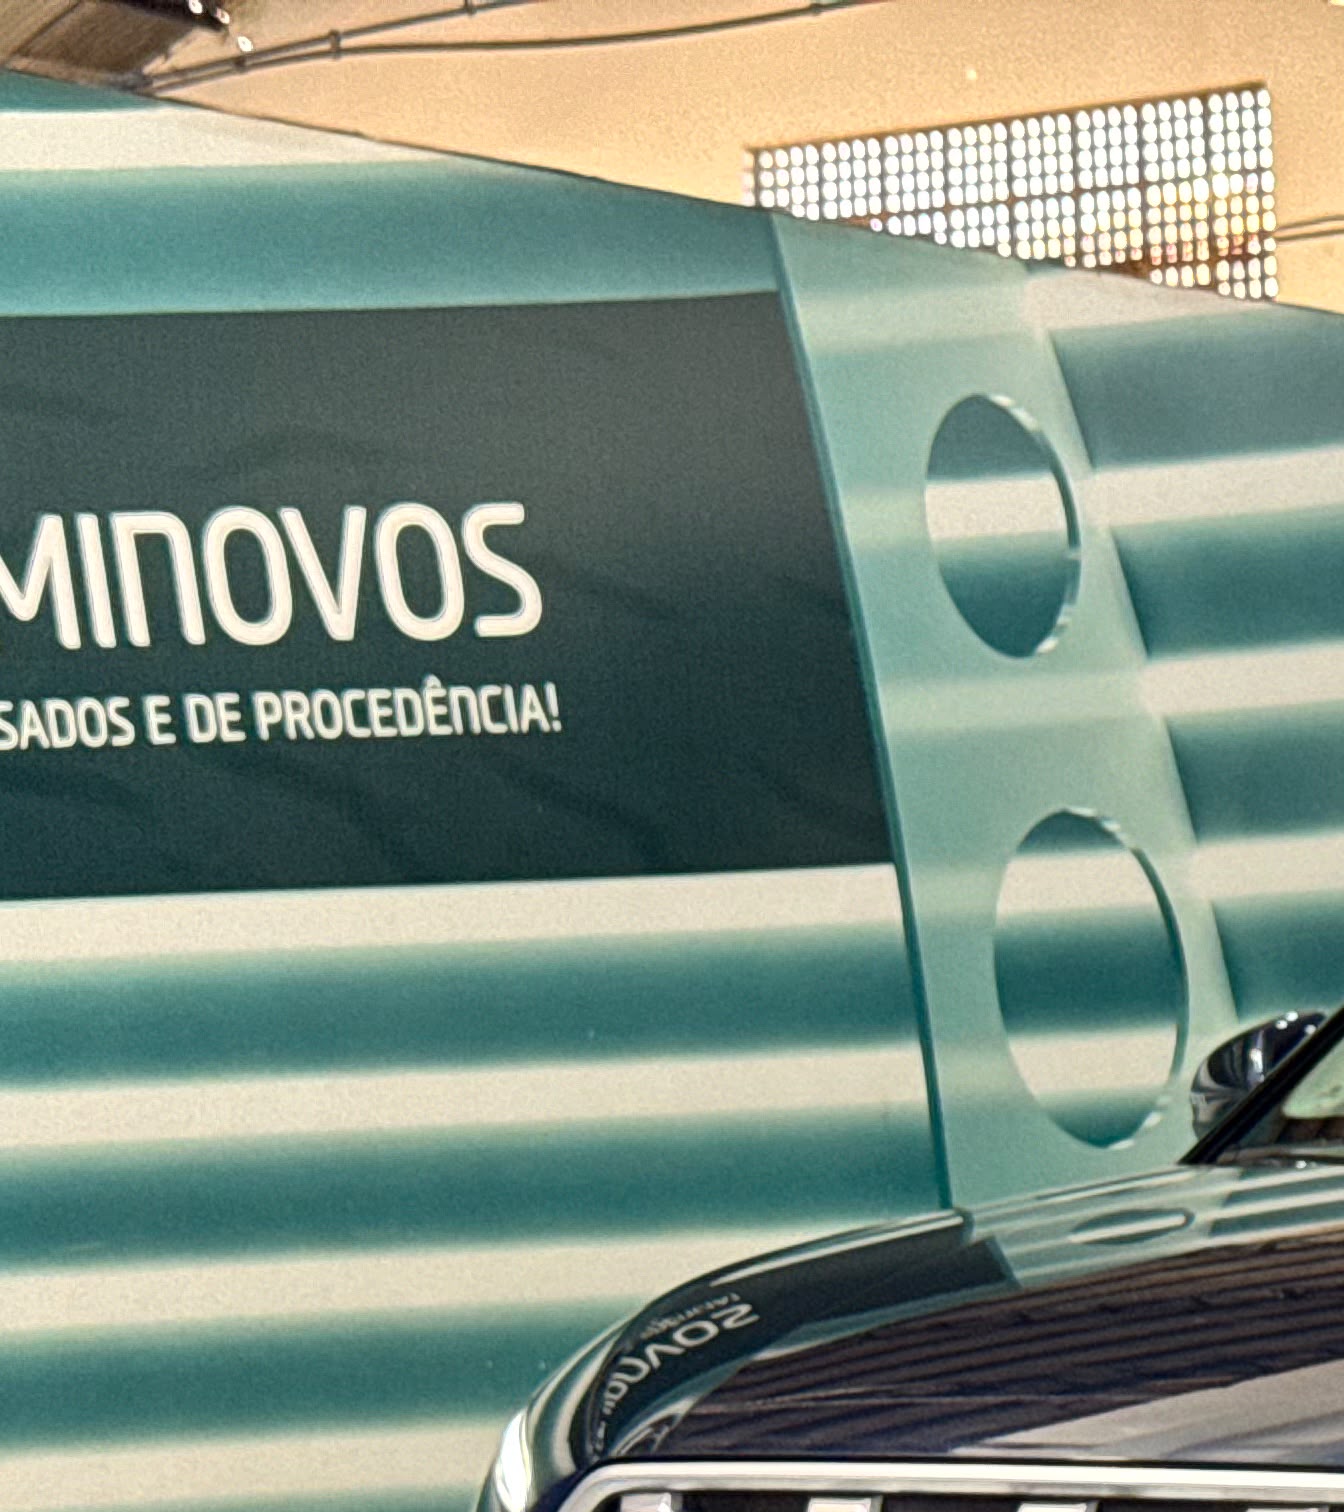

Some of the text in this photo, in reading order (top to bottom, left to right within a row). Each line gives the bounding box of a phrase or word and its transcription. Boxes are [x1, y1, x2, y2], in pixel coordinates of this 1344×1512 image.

[144, 694, 176, 745] E
[184, 692, 247, 744] DE
[253, 674, 562, 741] PROCEDÊNCIA!
